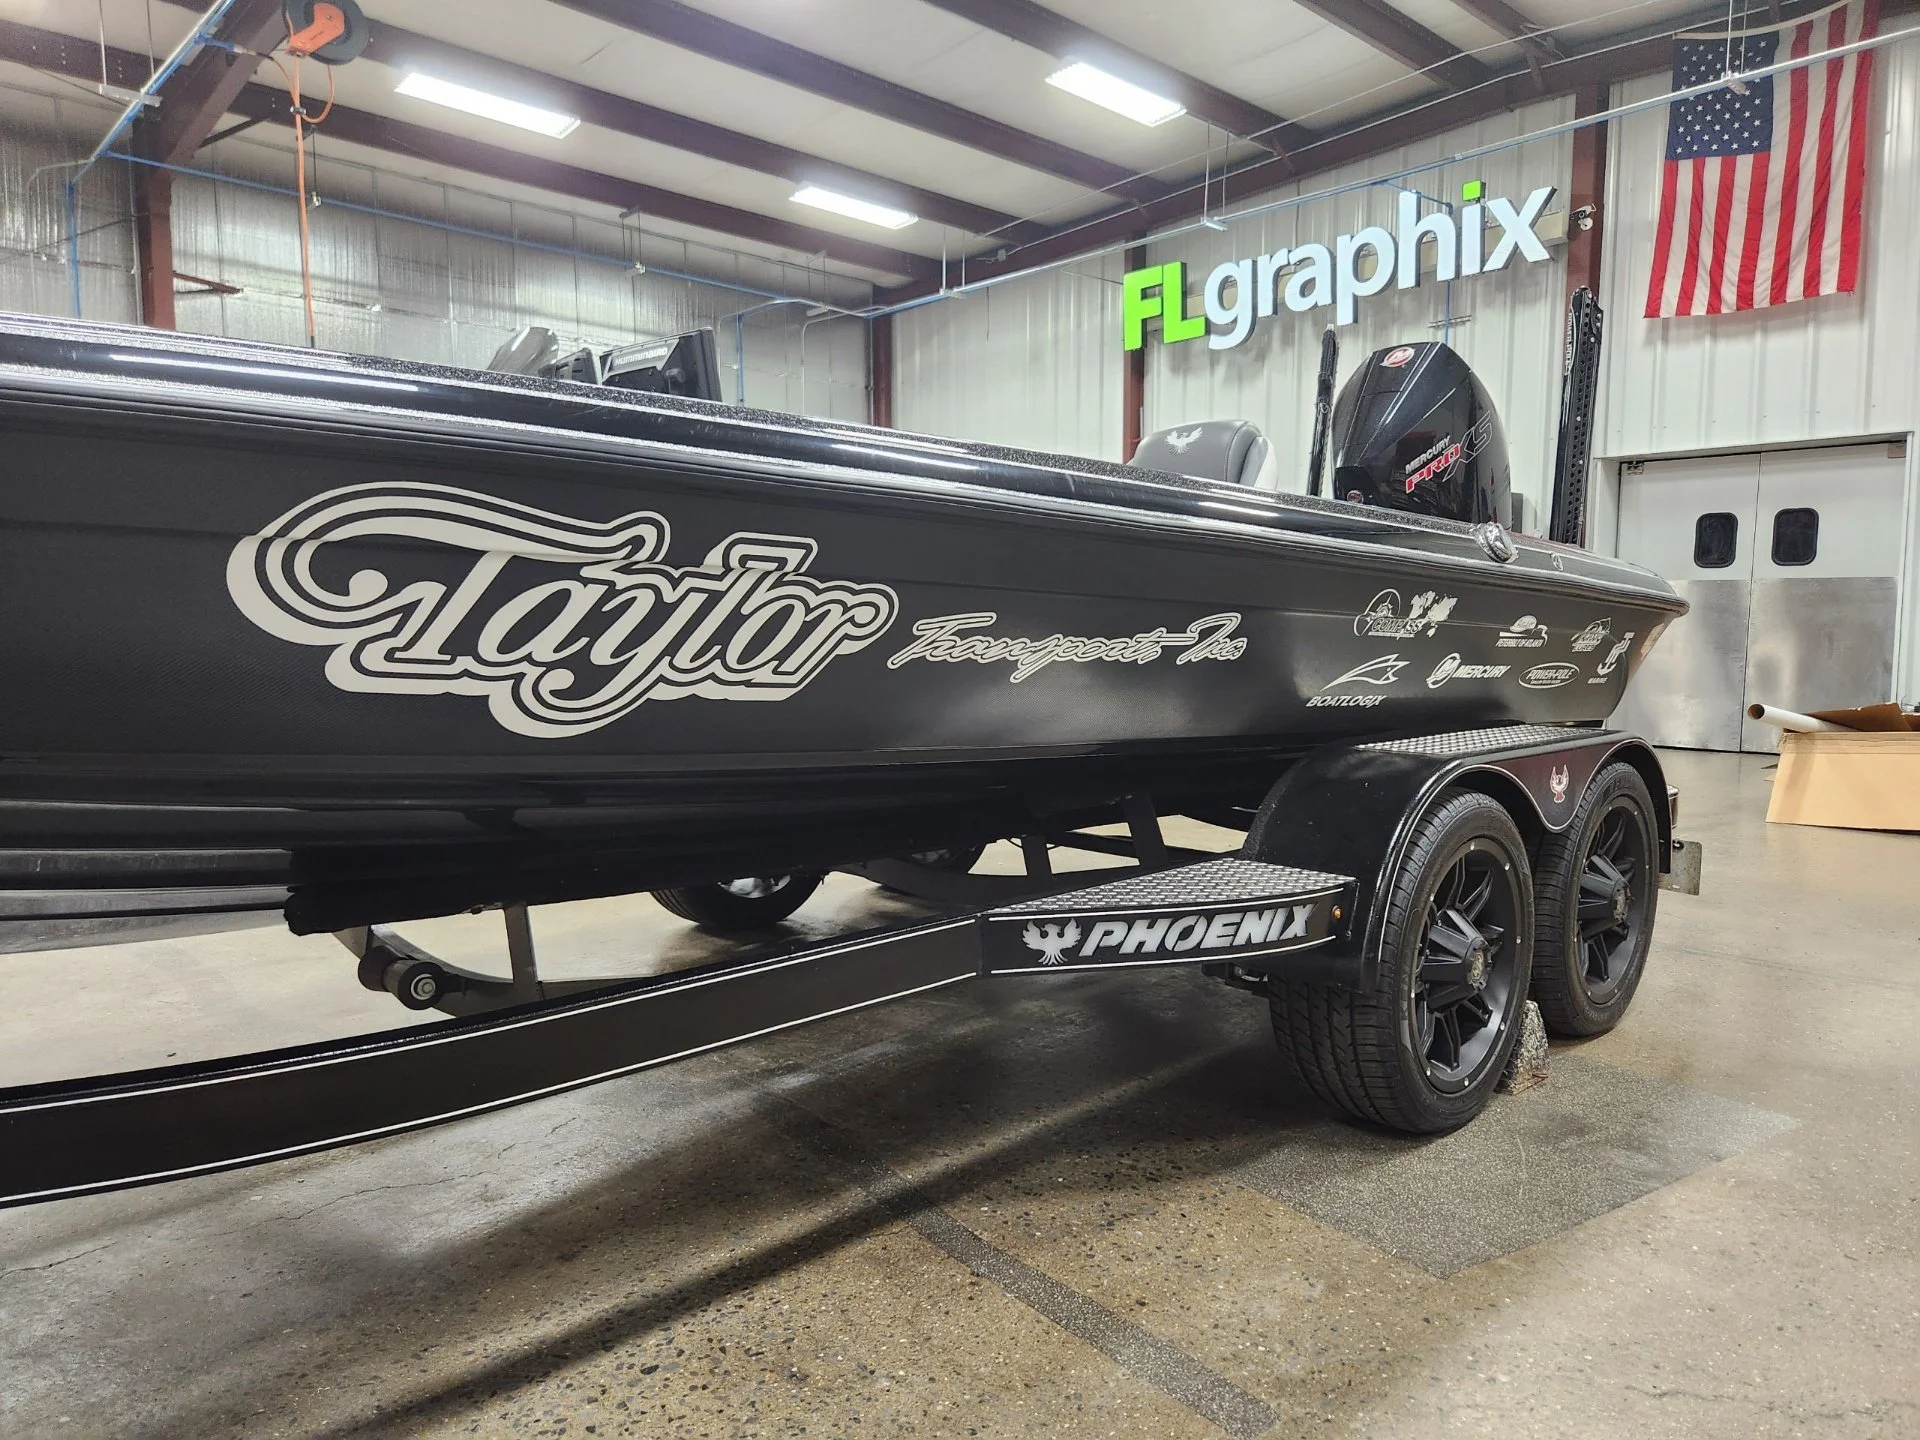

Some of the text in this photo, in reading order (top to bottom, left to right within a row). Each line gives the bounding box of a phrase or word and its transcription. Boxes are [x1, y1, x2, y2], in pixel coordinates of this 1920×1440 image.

[1405, 435, 1451, 475] MERCURY
[1406, 443, 1461, 494] PRO
[226, 481, 899, 738] Taylor
[1451, 665, 1512, 678] MERCURY
[1525, 668, 1576, 680] POWER-POLE
[1305, 695, 1388, 708] BOATLOGIX
[1078, 903, 1318, 957] PHOENIX
